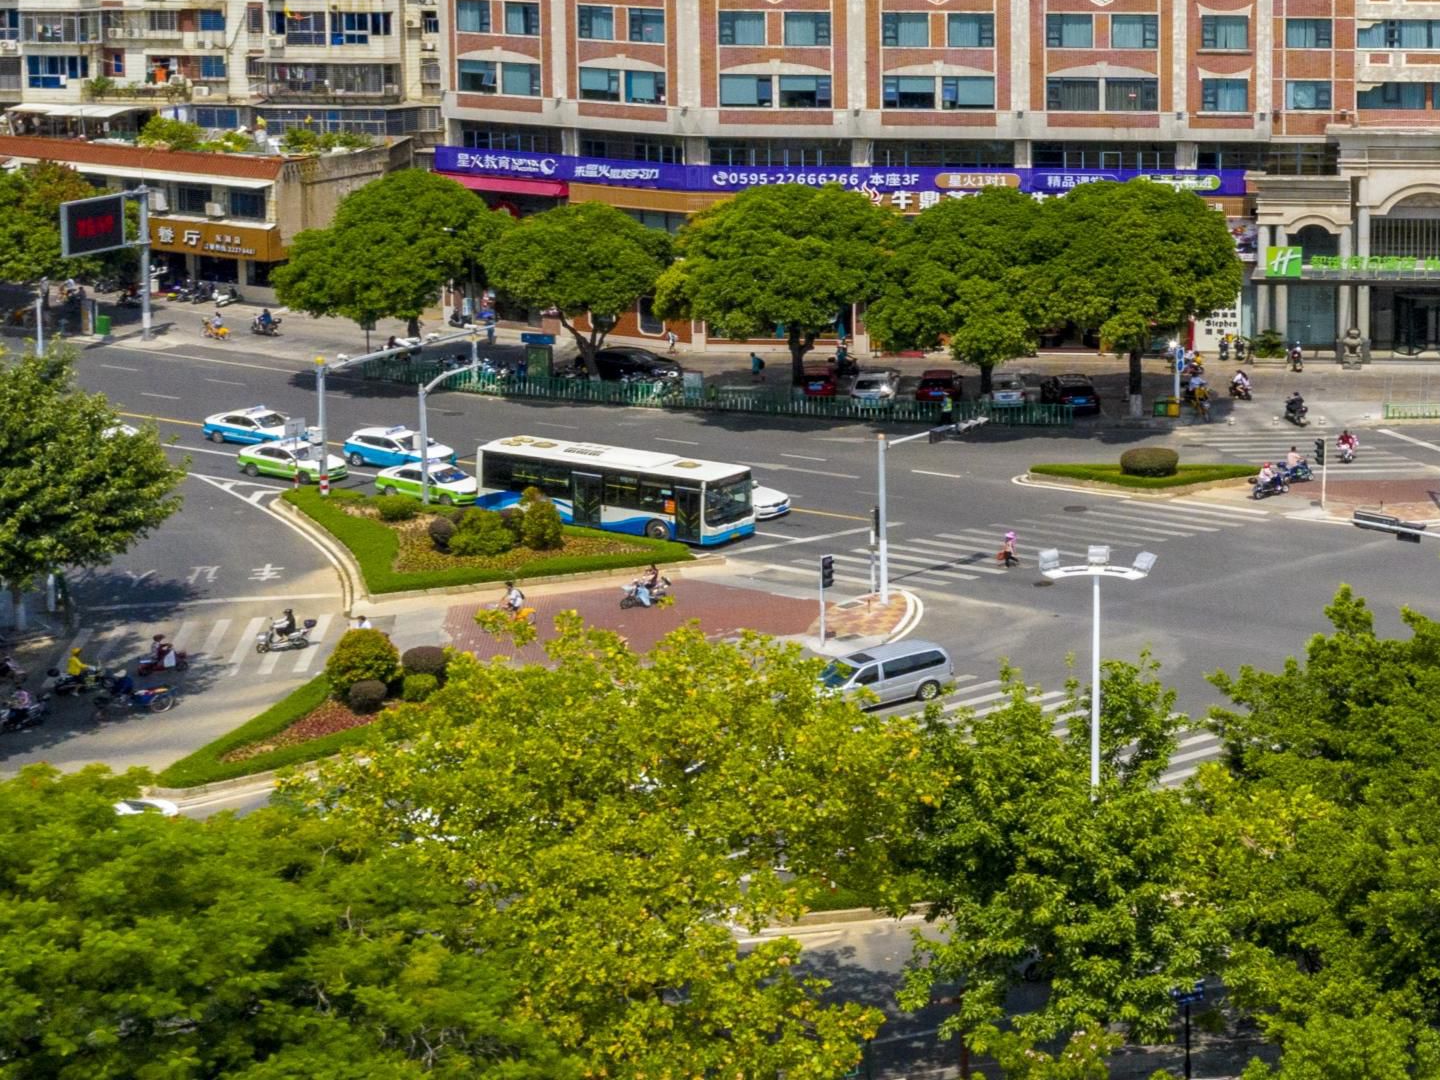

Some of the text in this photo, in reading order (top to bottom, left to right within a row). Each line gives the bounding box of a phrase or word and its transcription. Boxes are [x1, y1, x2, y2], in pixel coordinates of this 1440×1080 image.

[457, 153, 511, 170] 星火教育
[729, 172, 859, 186] 0595-22666266
[869, 173, 920, 187] 本座3F
[948, 174, 1007, 187] 星火1对1
[1205, 320, 1237, 328] Stephen
